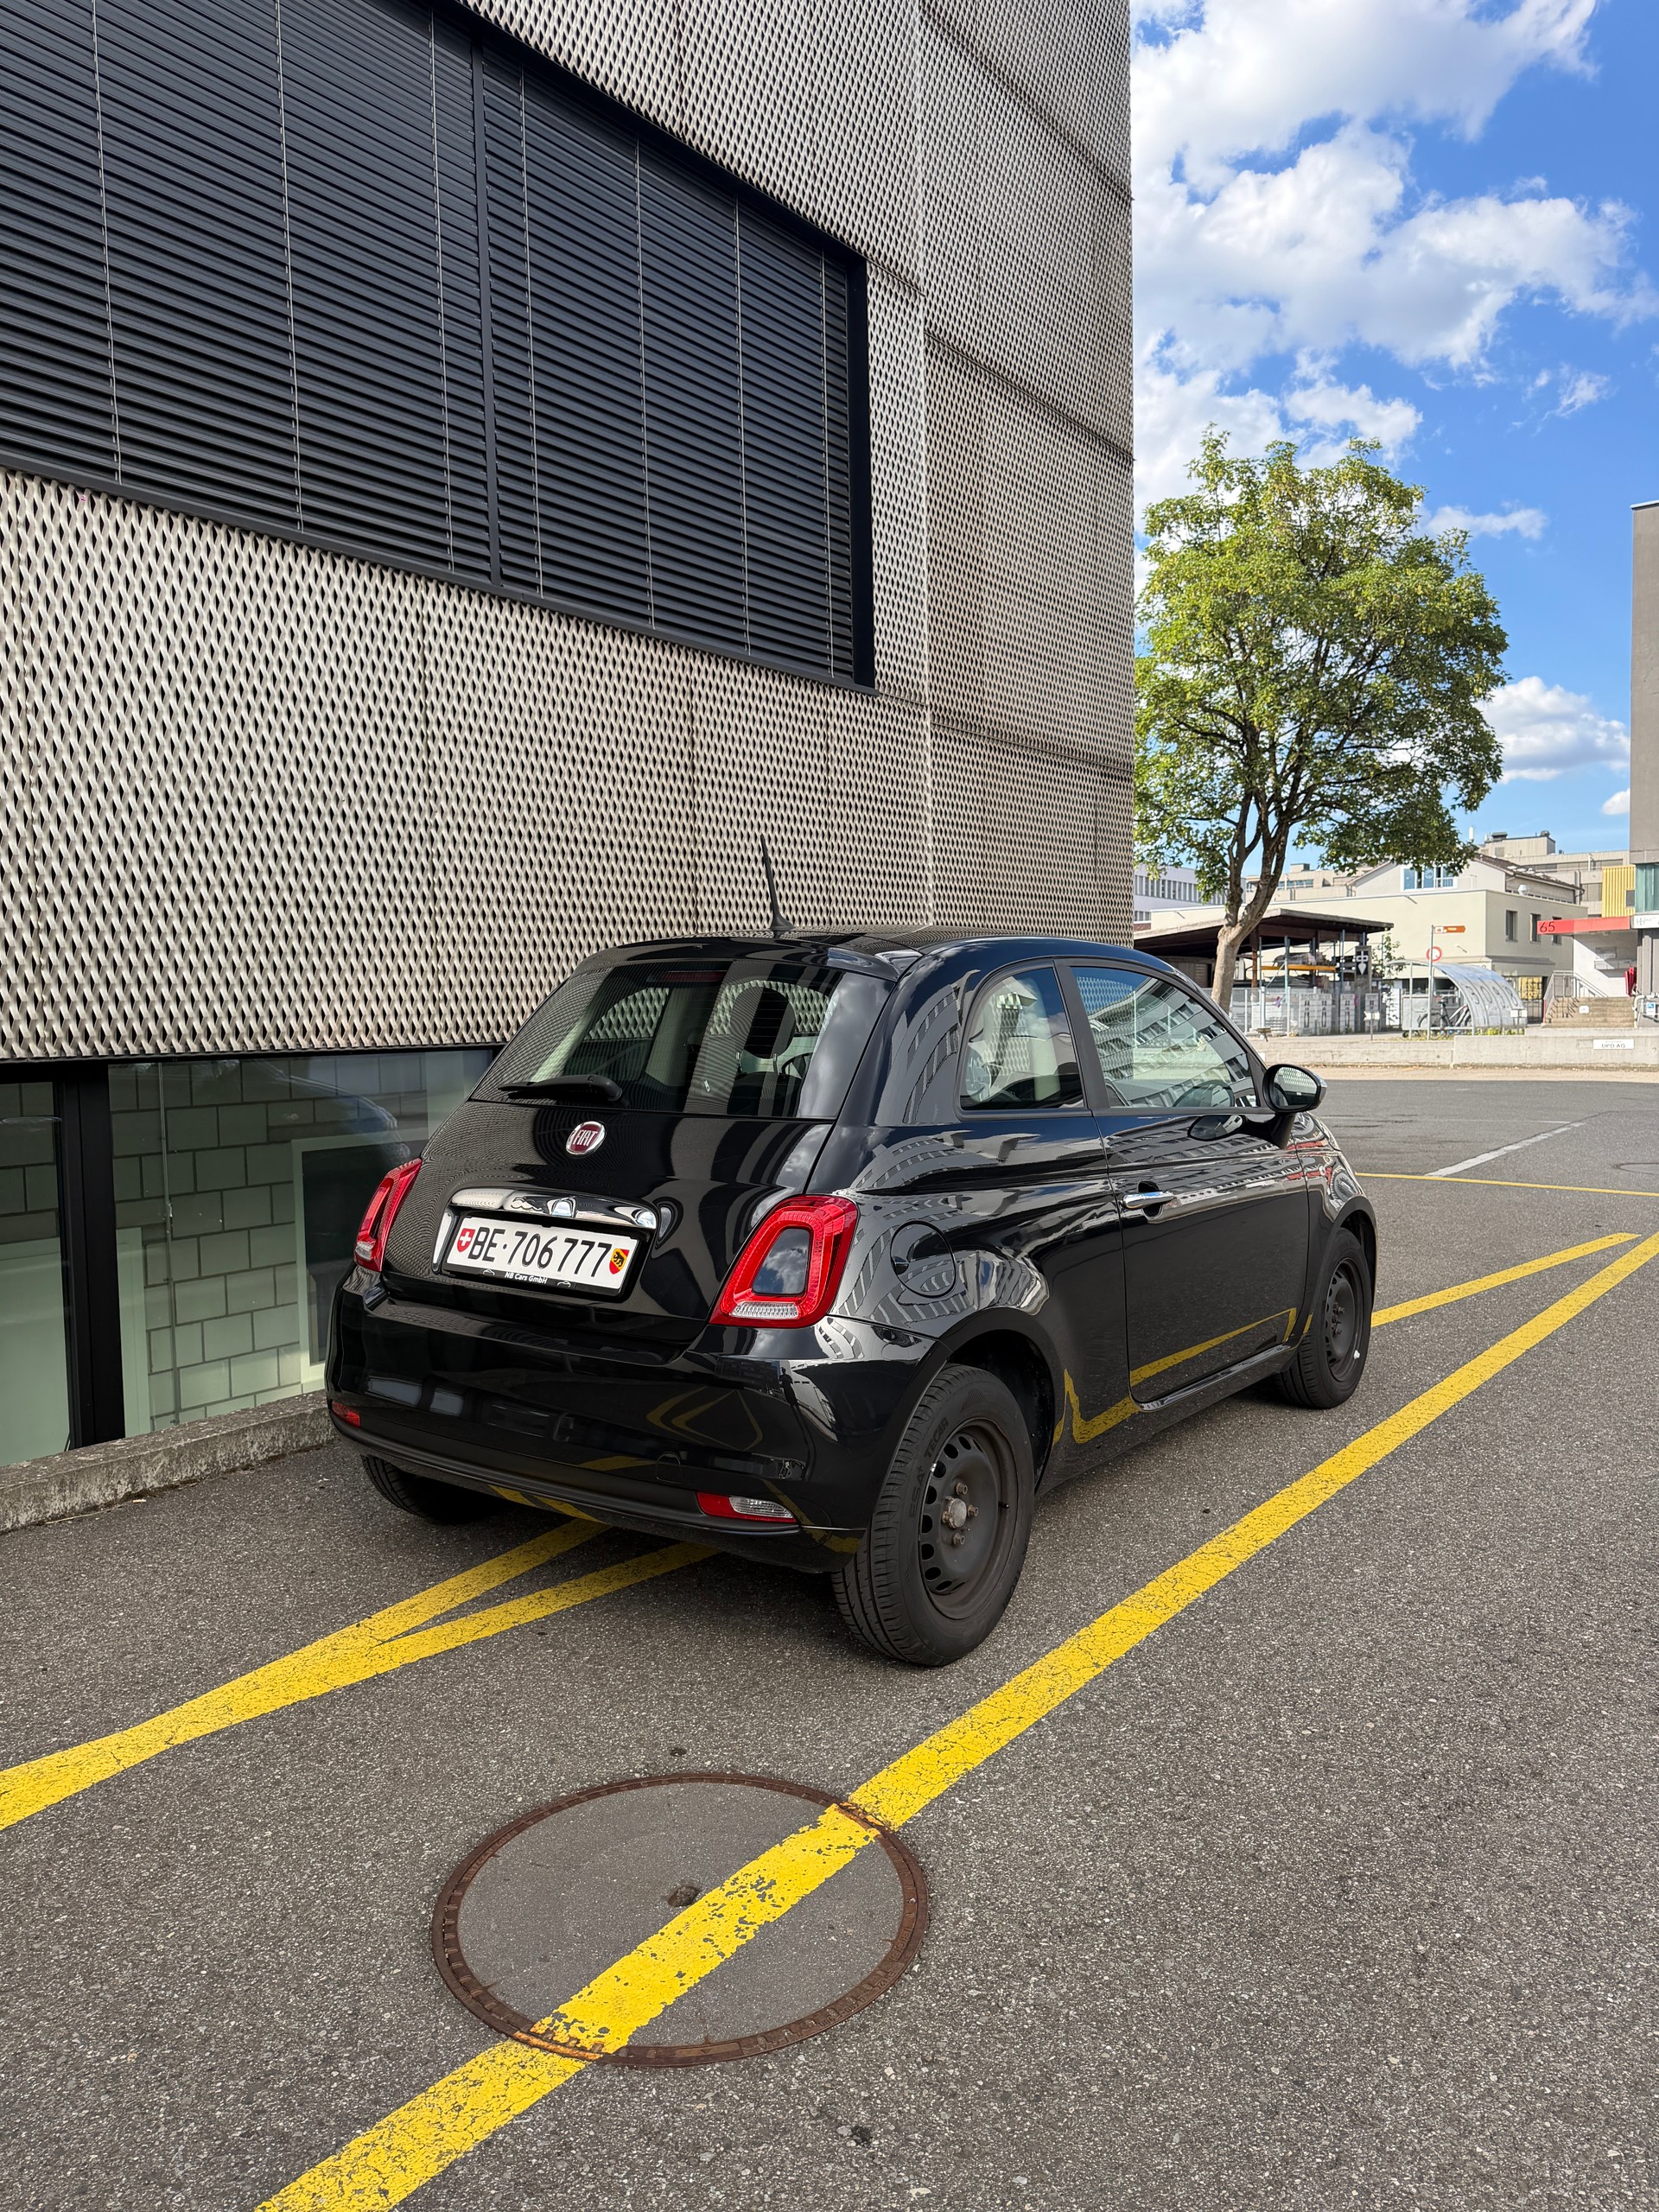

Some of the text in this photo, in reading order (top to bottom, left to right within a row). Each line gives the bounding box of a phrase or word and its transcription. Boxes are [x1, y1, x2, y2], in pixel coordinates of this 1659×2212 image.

[1540, 921, 1555, 932] 65
[572, 1129, 599, 1147] FIAT
[504, 1271, 548, 1285] NB Cars GmbH
[924, 1416, 950, 1459] TECAR
